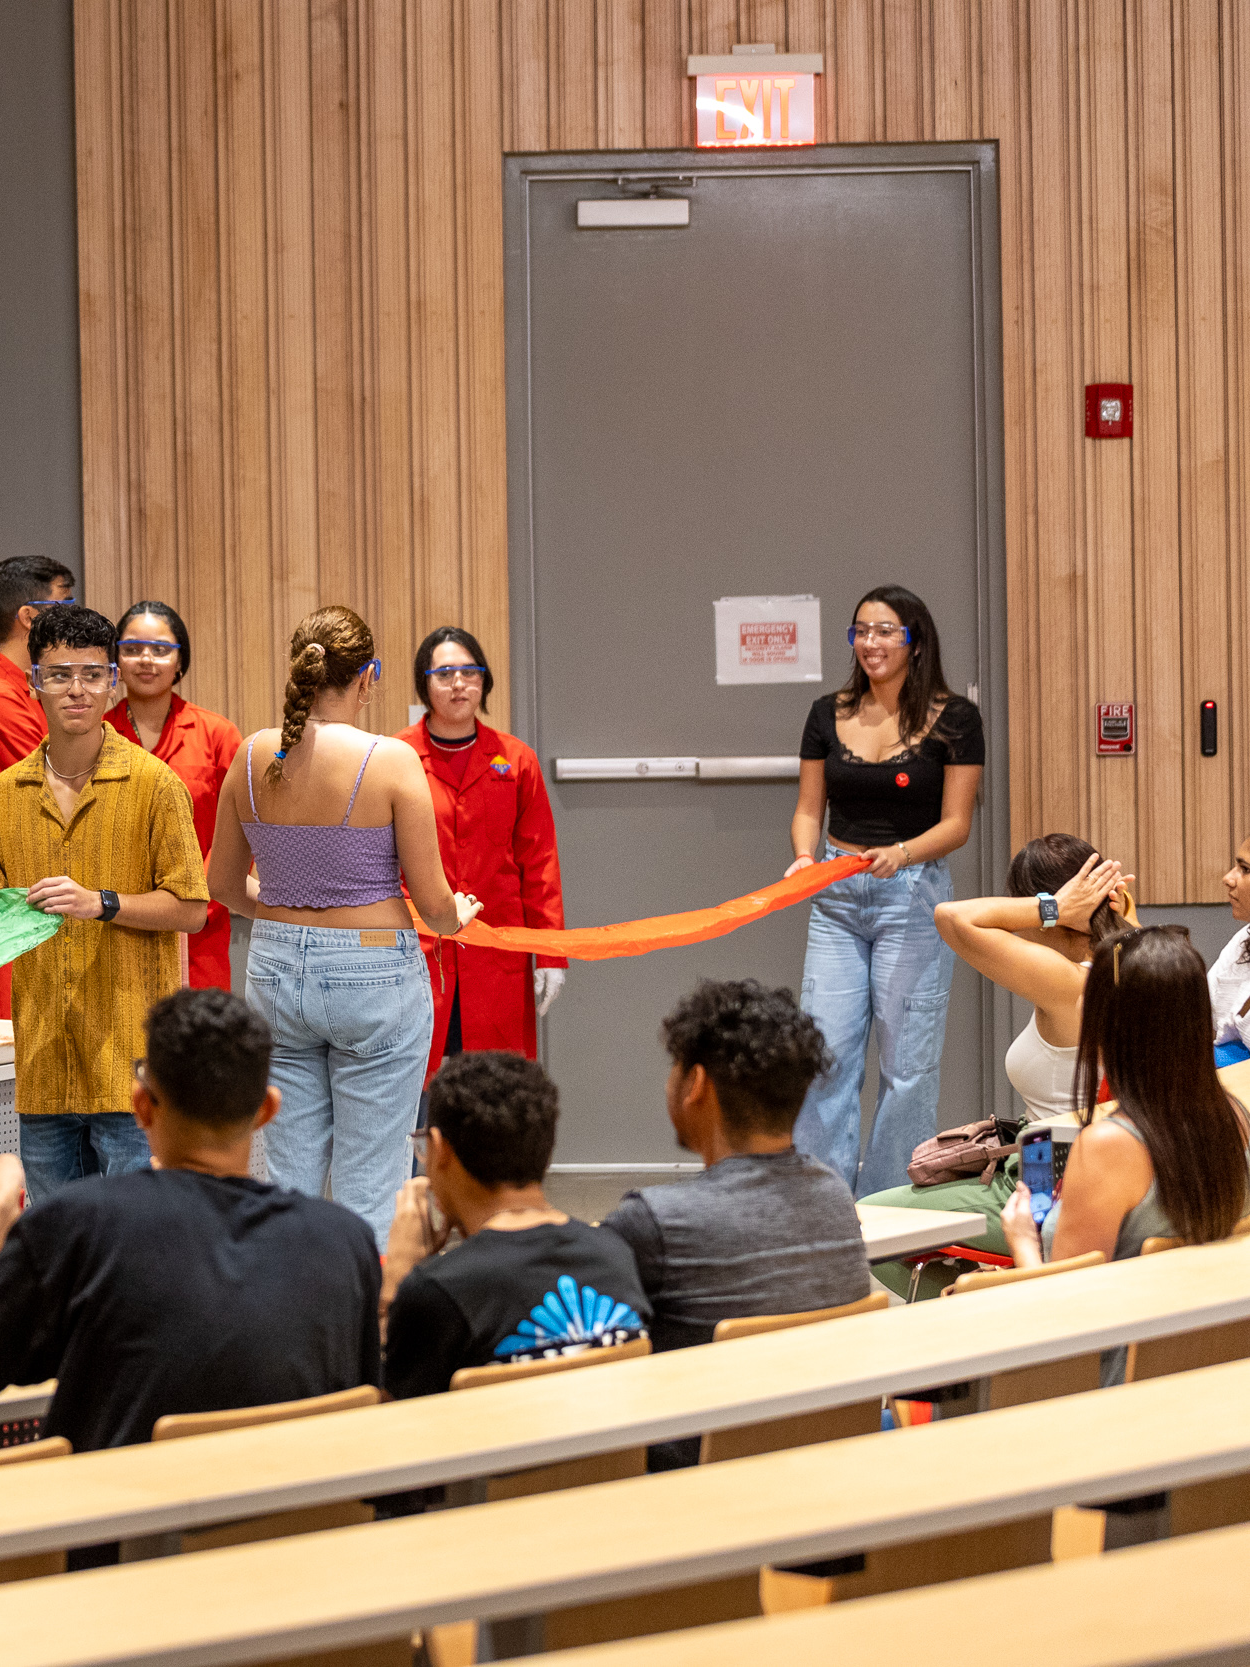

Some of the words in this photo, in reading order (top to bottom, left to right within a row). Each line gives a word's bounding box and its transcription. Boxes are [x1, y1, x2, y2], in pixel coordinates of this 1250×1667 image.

[716, 79, 795, 139] EXIT
[741, 623, 794, 634] EMERGENCY
[746, 635, 766, 645] EXIT
[767, 634, 790, 644] ONLY
[1101, 705, 1130, 716] FIRE
